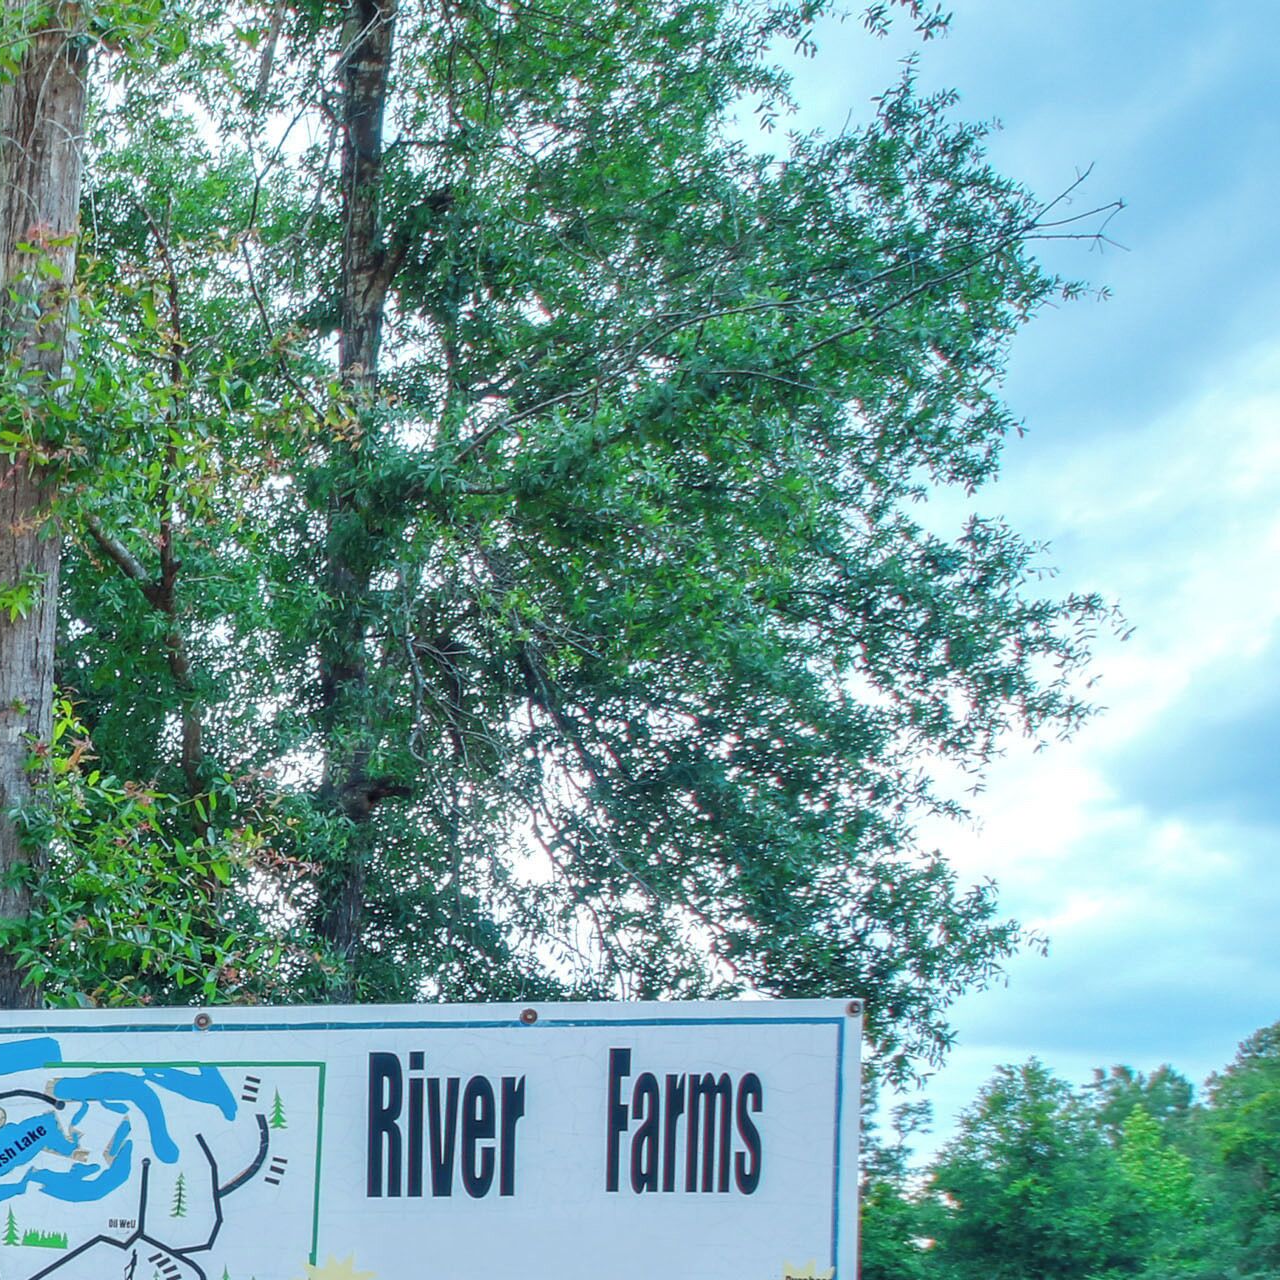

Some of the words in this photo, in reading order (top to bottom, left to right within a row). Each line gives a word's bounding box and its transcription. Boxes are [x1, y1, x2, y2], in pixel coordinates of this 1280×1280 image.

[17, 1125, 48, 1152] Lake
[366, 1051, 526, 1199] River
[605, 1047, 763, 1195] Farms
